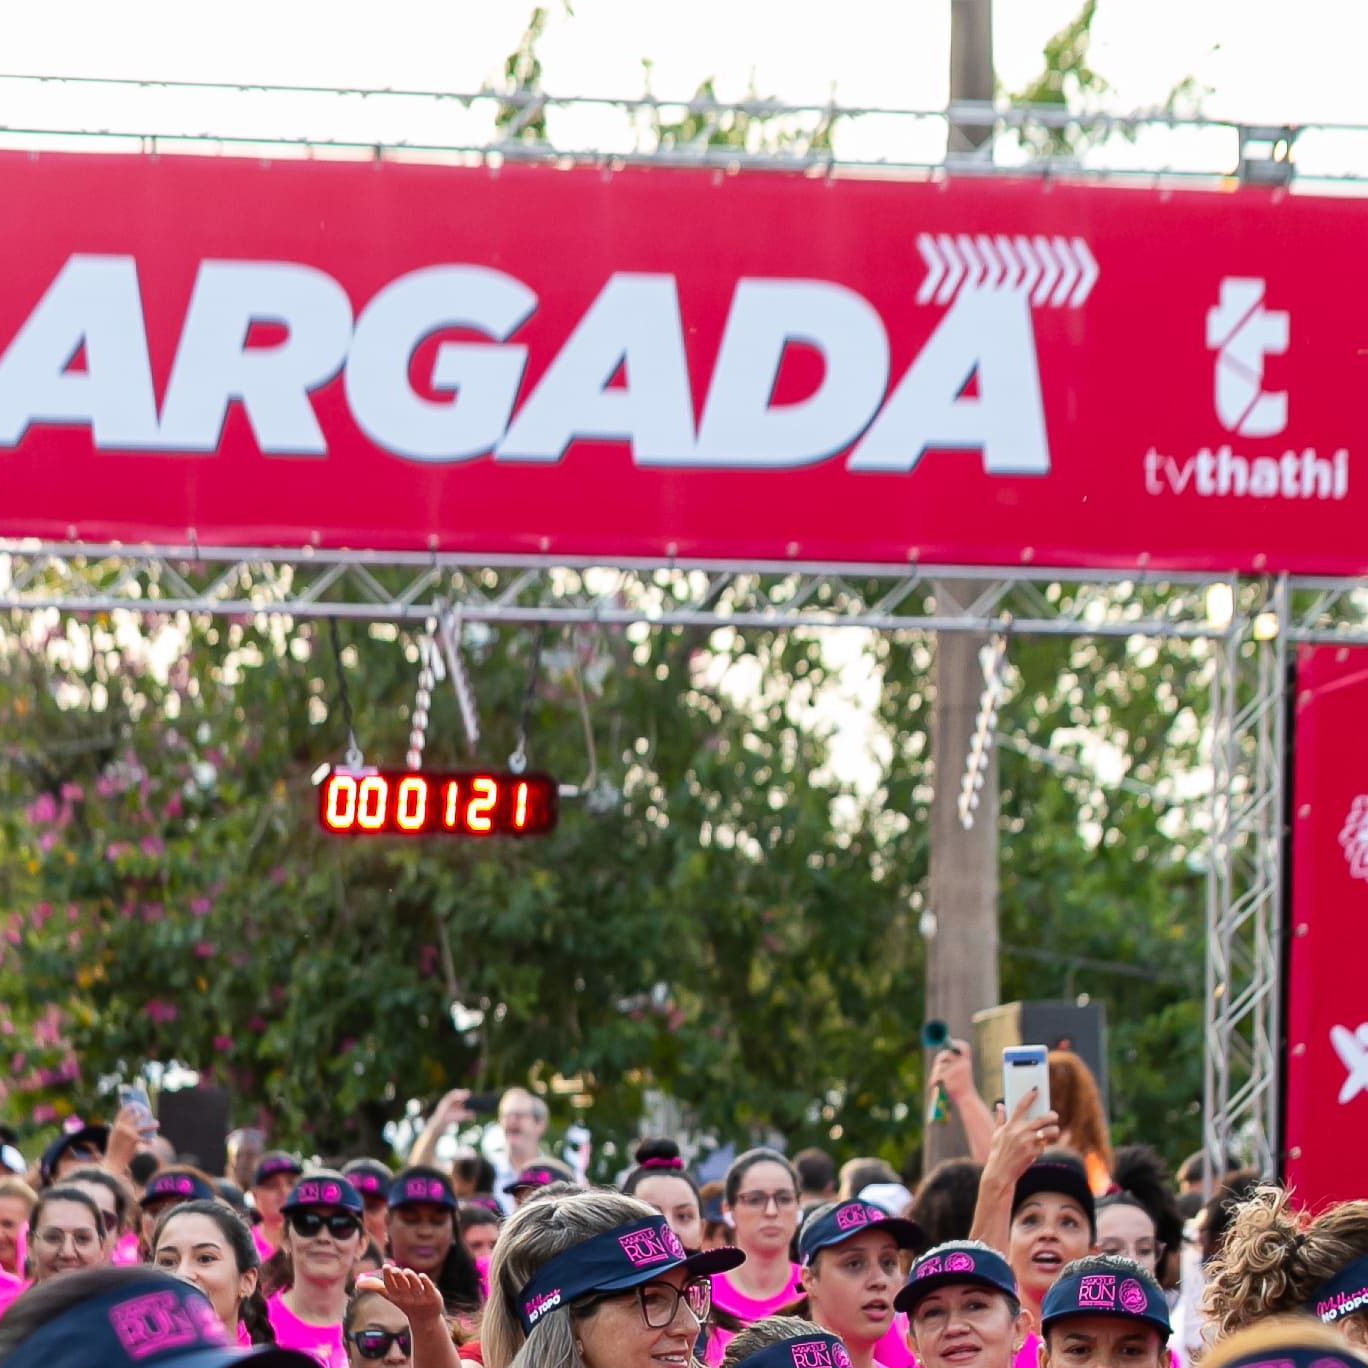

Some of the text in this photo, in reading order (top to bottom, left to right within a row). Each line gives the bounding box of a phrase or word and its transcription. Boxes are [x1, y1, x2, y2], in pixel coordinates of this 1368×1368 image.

[1144, 446, 1349, 500] tvthathi
[625, 1237, 666, 1262] RUN
[1080, 1284, 1116, 1301] RUN
[793, 1350, 832, 1368] RUN
